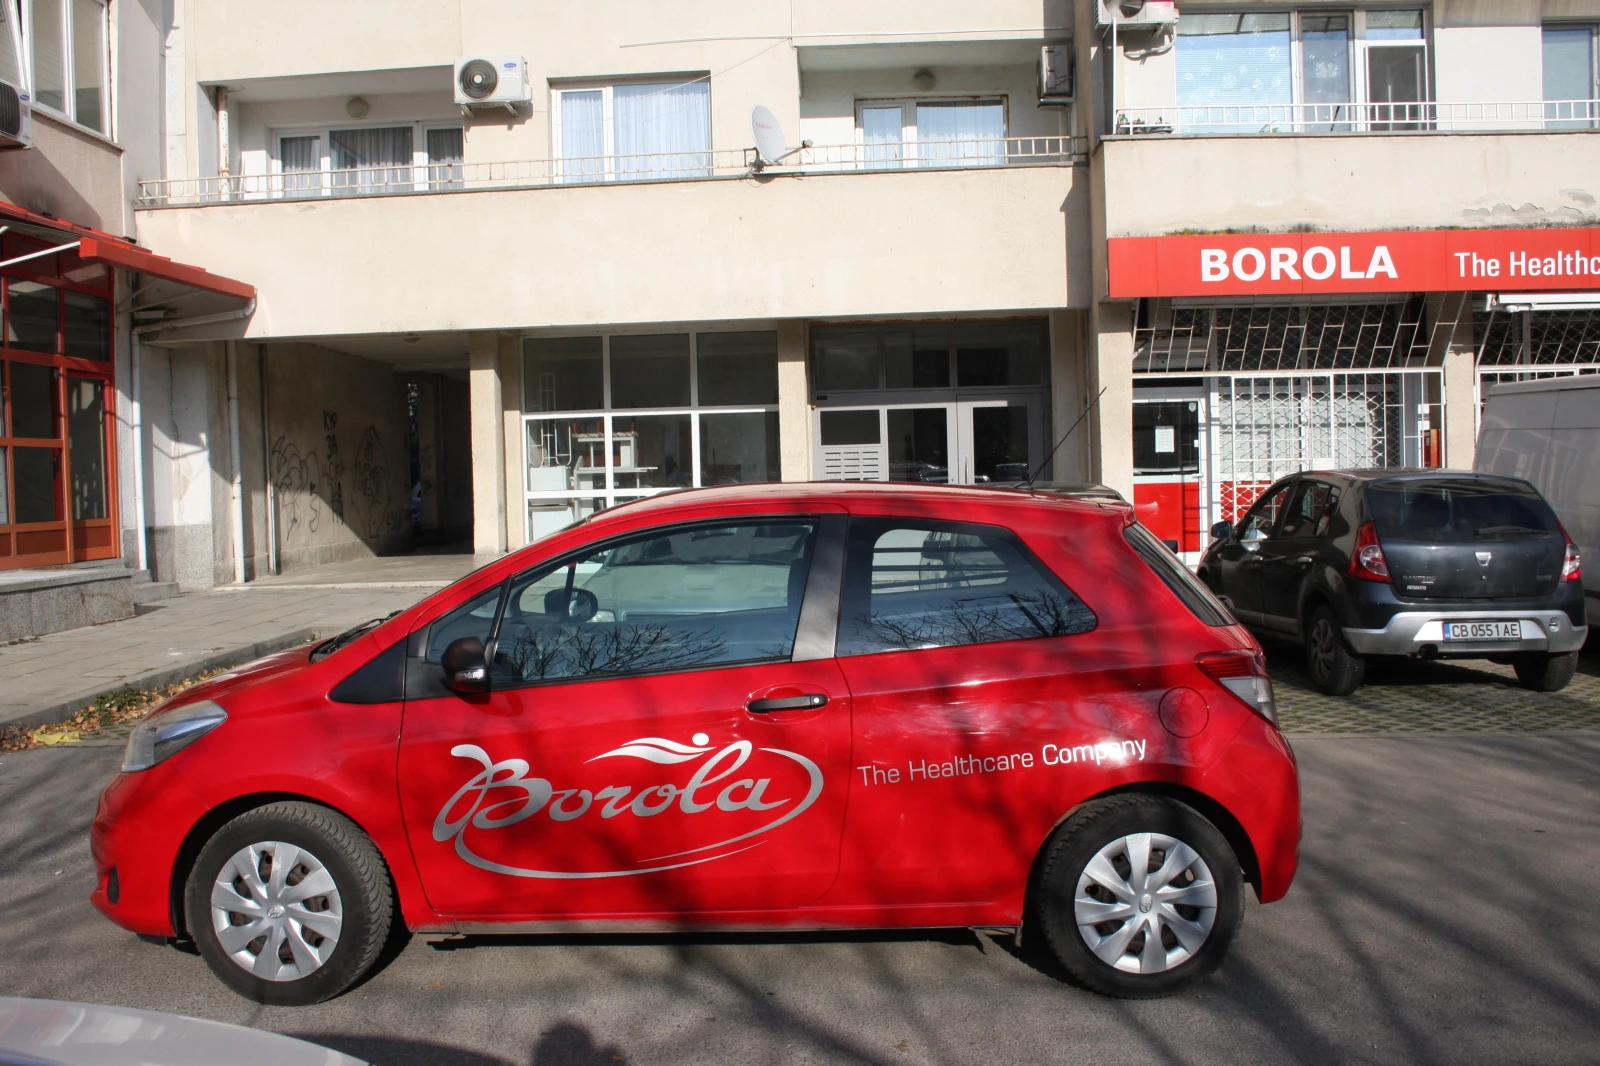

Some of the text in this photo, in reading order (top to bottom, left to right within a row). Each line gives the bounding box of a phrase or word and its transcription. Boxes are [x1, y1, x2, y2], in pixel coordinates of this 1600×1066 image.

[1200, 245, 1398, 282] BOROLA
[1453, 251, 1500, 278] The
[1451, 623, 1519, 638] CB 0551 AE
[857, 765, 900, 787] The
[908, 752, 1034, 781] Healthcare
[432, 739, 792, 842] Borola
